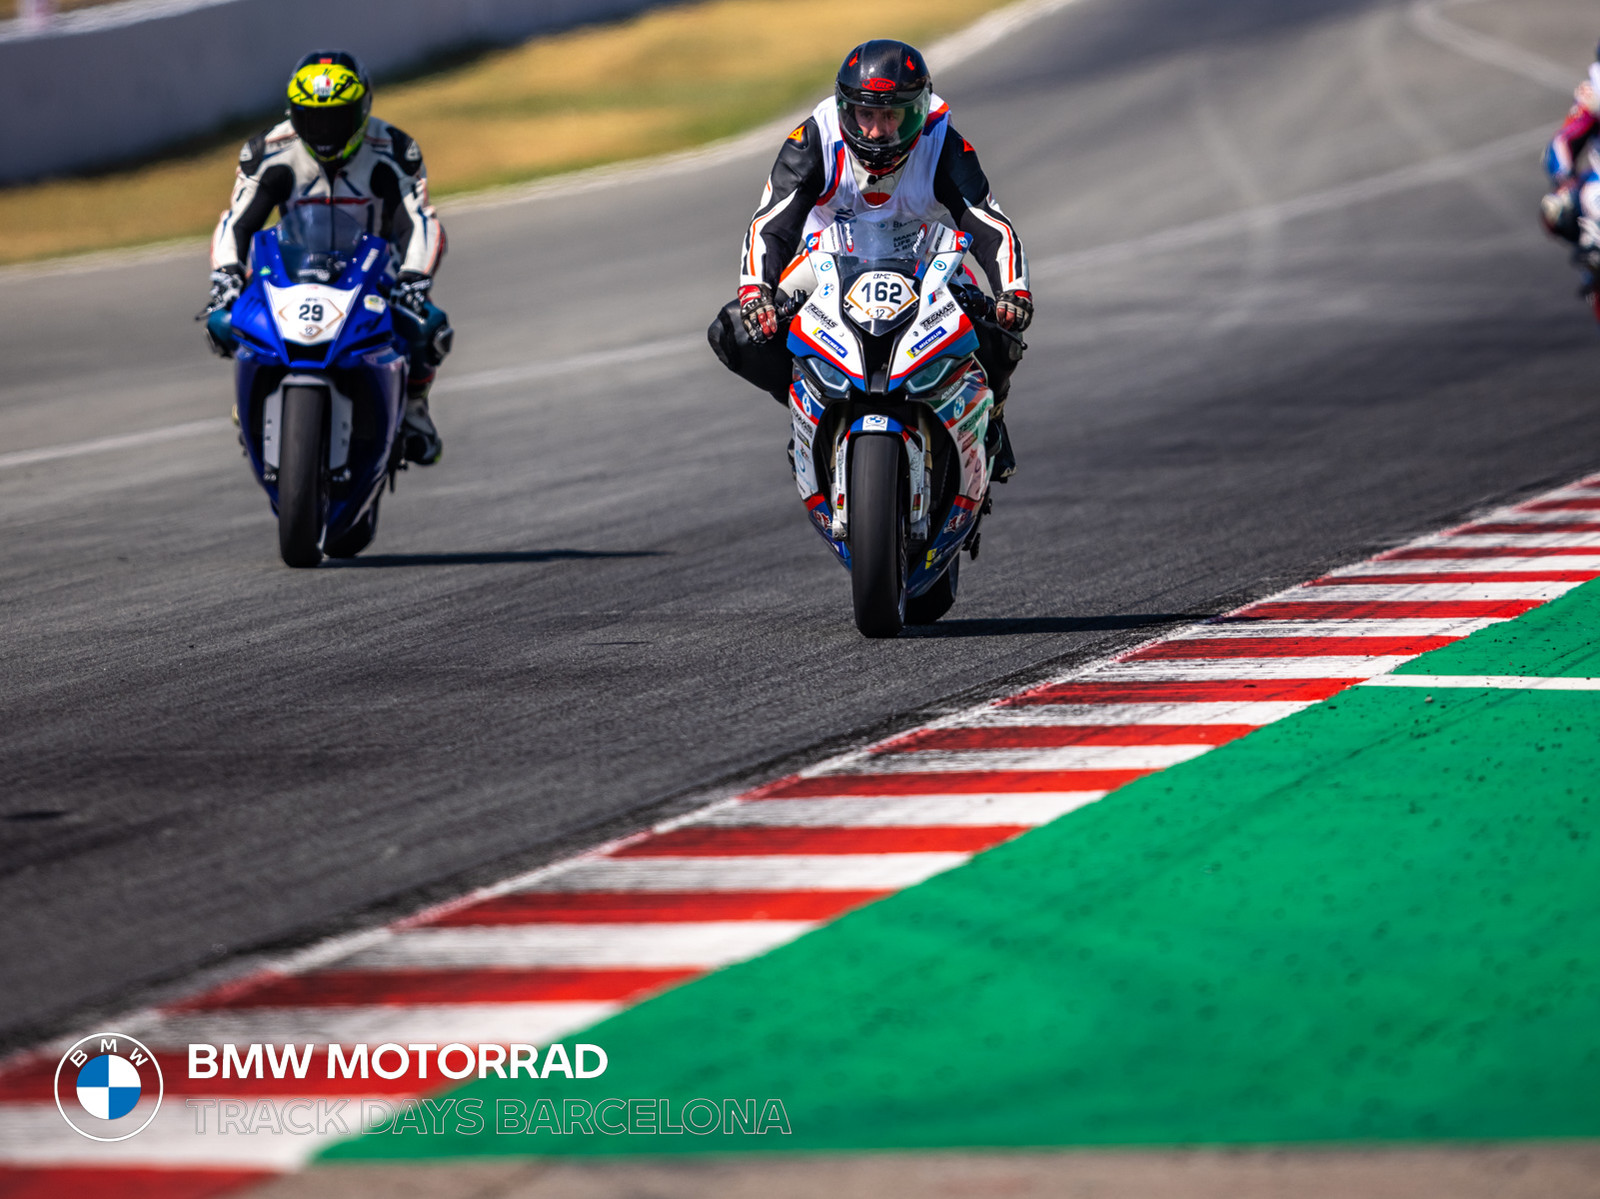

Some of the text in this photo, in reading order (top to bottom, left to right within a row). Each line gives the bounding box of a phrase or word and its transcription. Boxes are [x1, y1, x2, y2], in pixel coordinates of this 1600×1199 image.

[861, 281, 902, 305] 162
[298, 304, 324, 322] 29
[876, 308, 885, 318] 12
[821, 335, 845, 355] MICHELIN
[917, 329, 943, 350] MICHELIN
